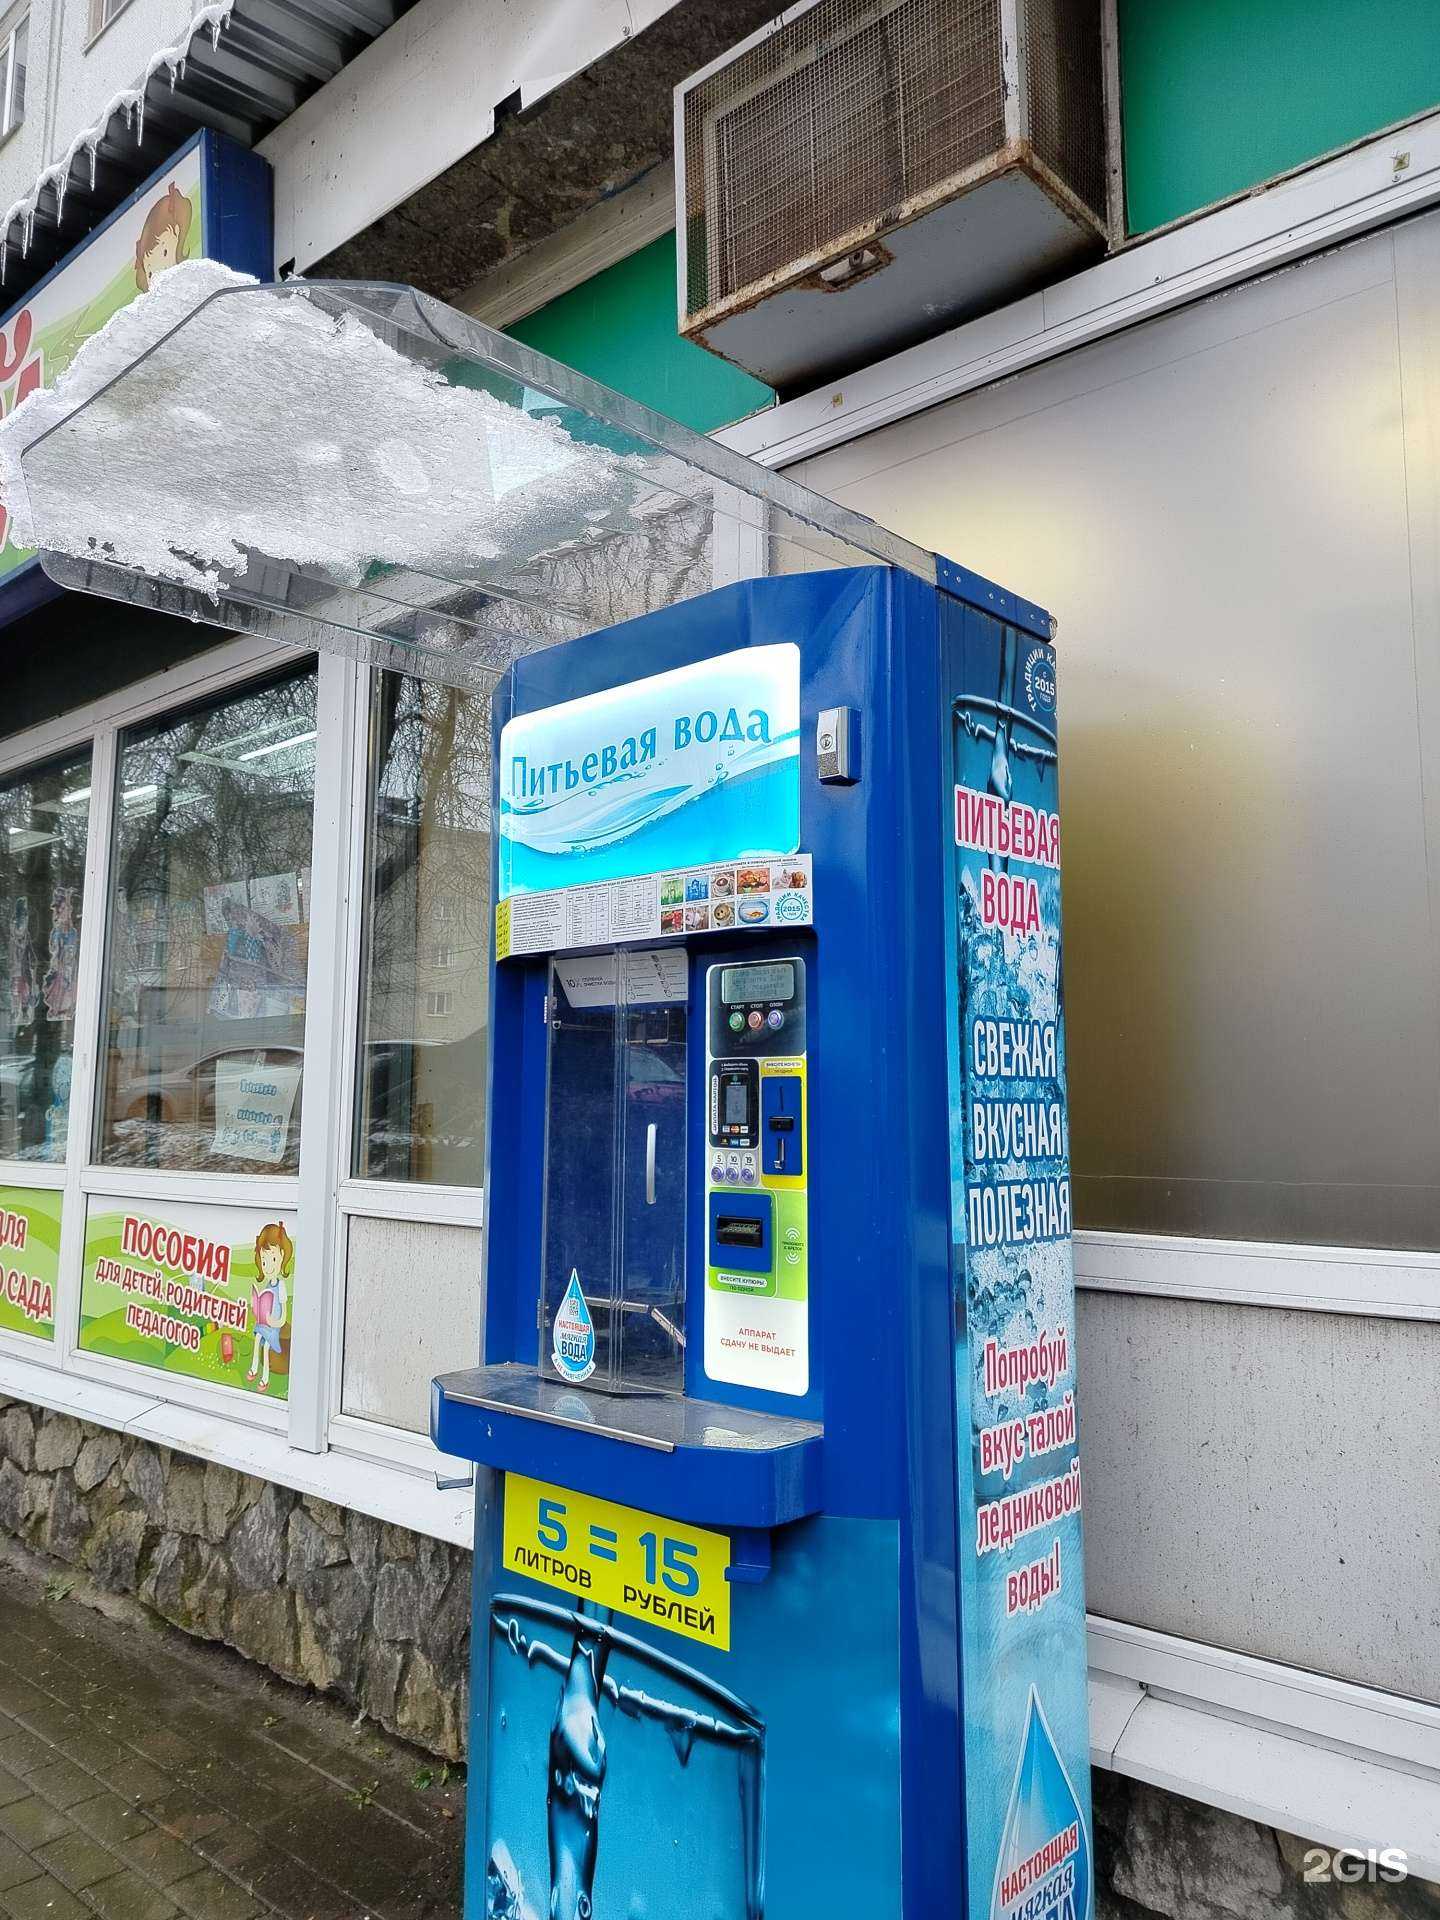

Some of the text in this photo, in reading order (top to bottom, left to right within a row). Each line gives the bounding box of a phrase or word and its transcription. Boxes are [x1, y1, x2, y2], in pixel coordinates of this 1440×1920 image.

[1035, 677, 1055, 696] 2015
[511, 707, 772, 799] Питьевая вода
[957, 790, 1061, 866] ПИТЬЕВАЯ
[983, 873, 1040, 938] ВОДА
[973, 1020, 1057, 1077] СВЕЖАЯ
[973, 1103, 1063, 1160] ВКУСНАЯ
[969, 1181, 1071, 1247] ПОЛЕЗНАЯ
[122, 1218, 231, 1282] ПОСОБИЯ
[7, 1271, 52, 1319] САДА
[96, 1259, 121, 1283] ДЛЯ
[166, 1283, 248, 1330] РОДИТЕЛЕЙ
[127, 1305, 200, 1350] ПЕДАГОГОВ
[561, 1341, 586, 1360] ВОДА
[720, 1337, 796, 1357] СДАЧУ НЕ ВЫДАЕТ
[738, 1327, 777, 1341] АППАРАТ
[984, 1326, 1067, 1394] Попробуй
[981, 1395, 1074, 1475] вкус талой
[978, 1463, 1080, 1549] ледниковой
[537, 1497, 568, 1552] 5
[638, 1531, 700, 1597] 15
[1007, 1542, 1060, 1614] воды!
[514, 1547, 716, 1635] ЛИТРОВ РУБЛЕЙ
[1001, 1823, 1077, 1906] НАСТОЯЩАЯ
